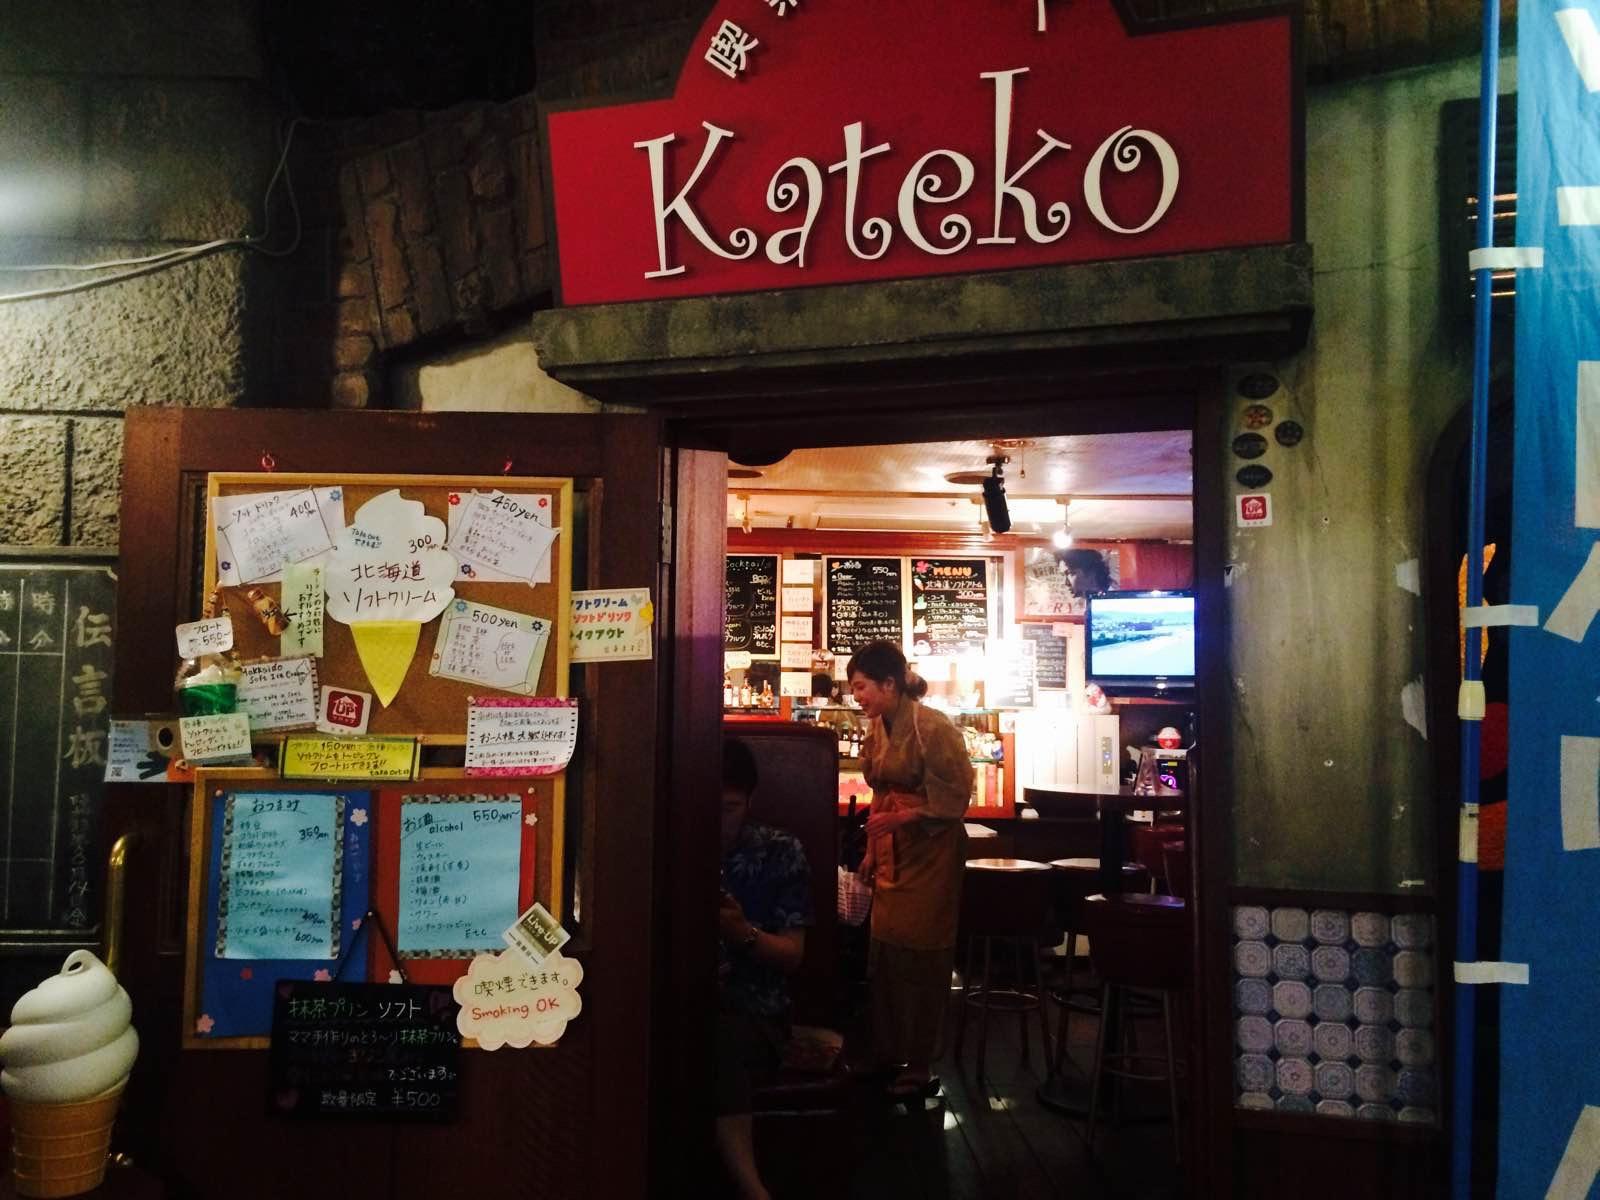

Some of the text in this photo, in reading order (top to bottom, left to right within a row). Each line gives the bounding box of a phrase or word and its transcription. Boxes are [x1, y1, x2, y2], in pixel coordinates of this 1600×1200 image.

[633, 67, 1180, 280] Kateko
[491, 495, 539, 522] 450yen
[351, 560, 425, 582] 北海道
[933, 566, 973, 577] MENU
[343, 588, 437, 612] ソフトクリーム
[472, 609, 519, 629] 500yen
[64, 605, 113, 768] 伝言板
[252, 798, 301, 813] おつまみ
[429, 822, 464, 834] alcohol
[475, 972, 569, 997] 喫煙できます。
[379, 999, 422, 1020] ソフト
[472, 998, 560, 1021] Smoking OK
